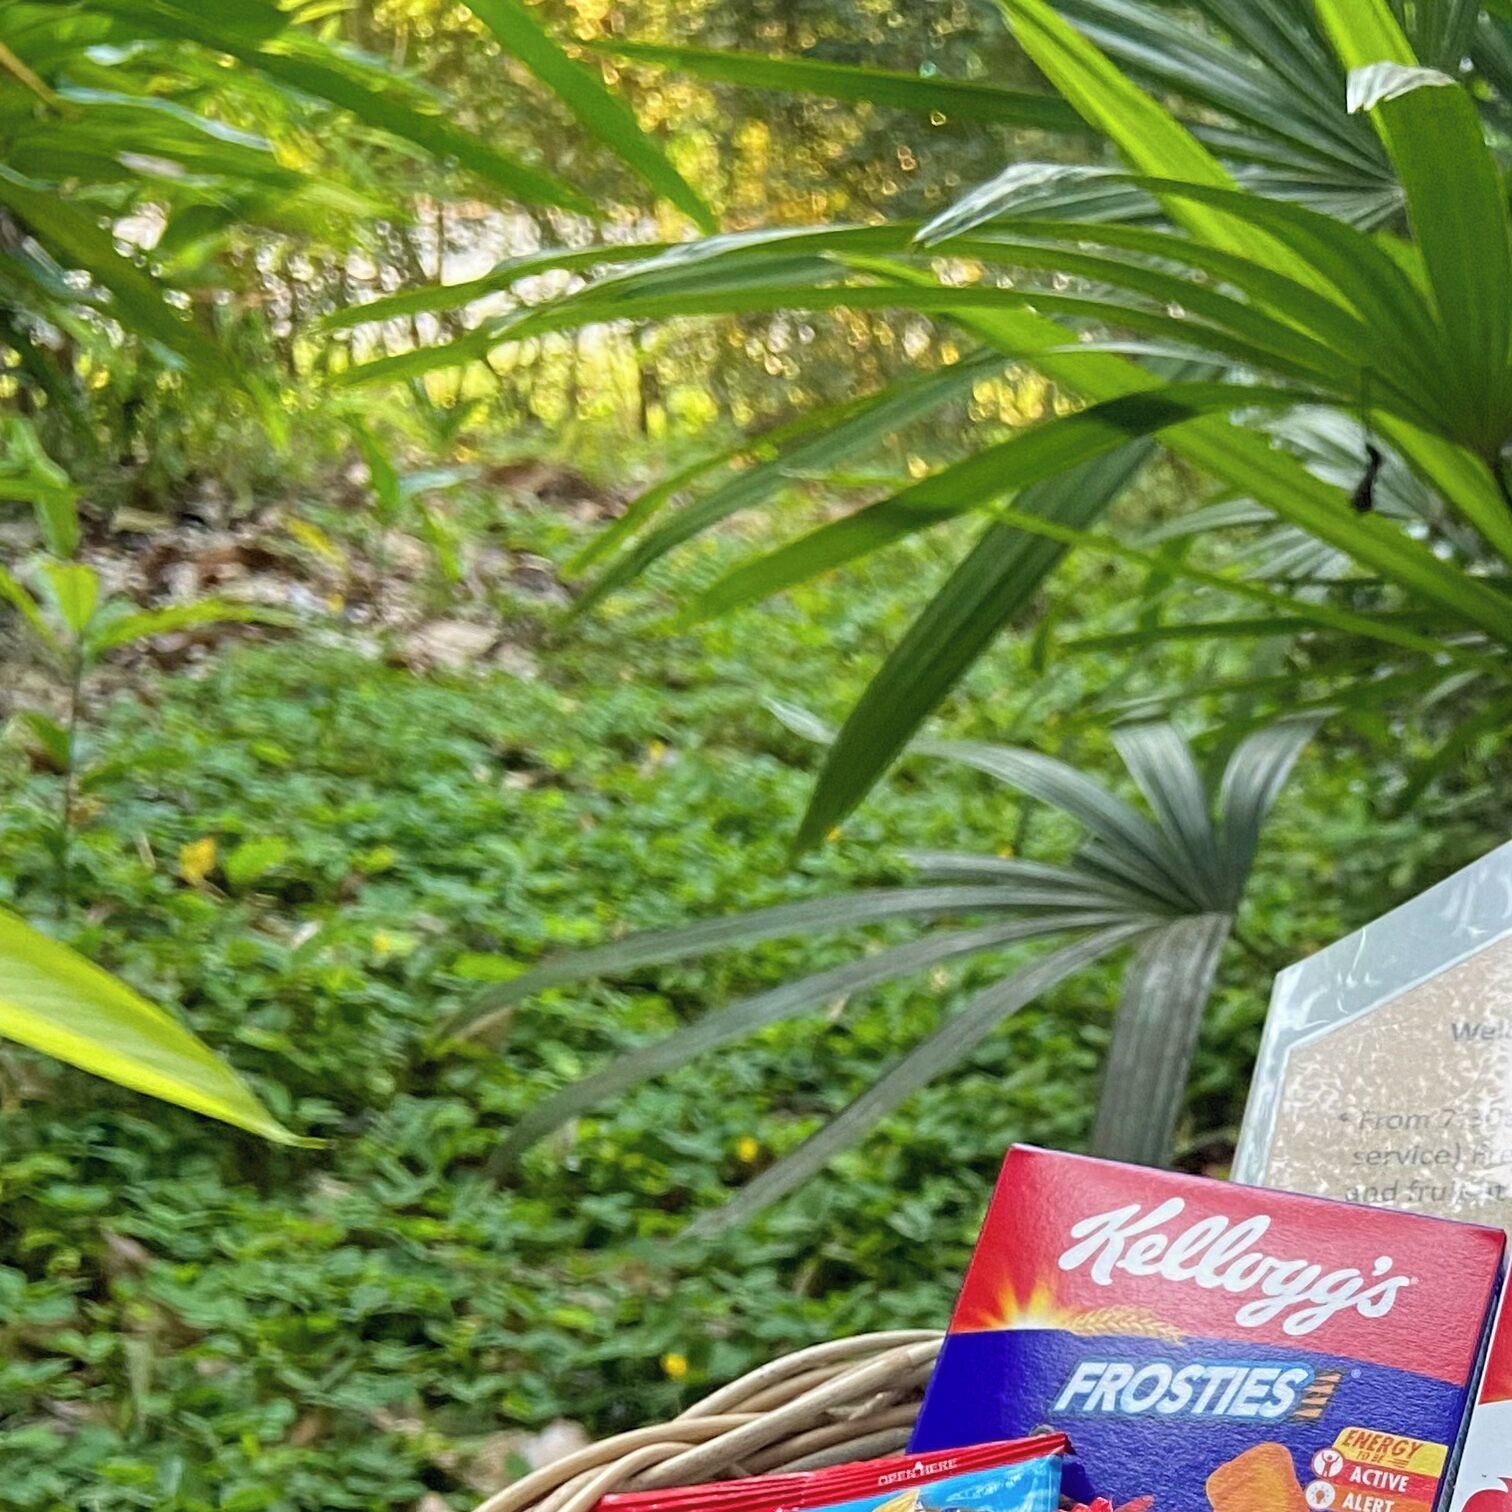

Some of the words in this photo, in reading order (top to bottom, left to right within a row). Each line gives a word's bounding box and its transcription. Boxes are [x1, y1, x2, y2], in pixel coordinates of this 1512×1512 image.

[1359, 1110, 1429, 1131] From
[1353, 1142, 1461, 1169] service)
[1345, 1180, 1397, 1202] and
[1406, 1180, 1468, 1202] fru
[1058, 1197, 1410, 1336] Kellogg's
[1053, 1361, 1310, 1419] FROSTIES
[1342, 1429, 1424, 1459] ENERGY
[1349, 1466, 1410, 1493] ACTIVE
